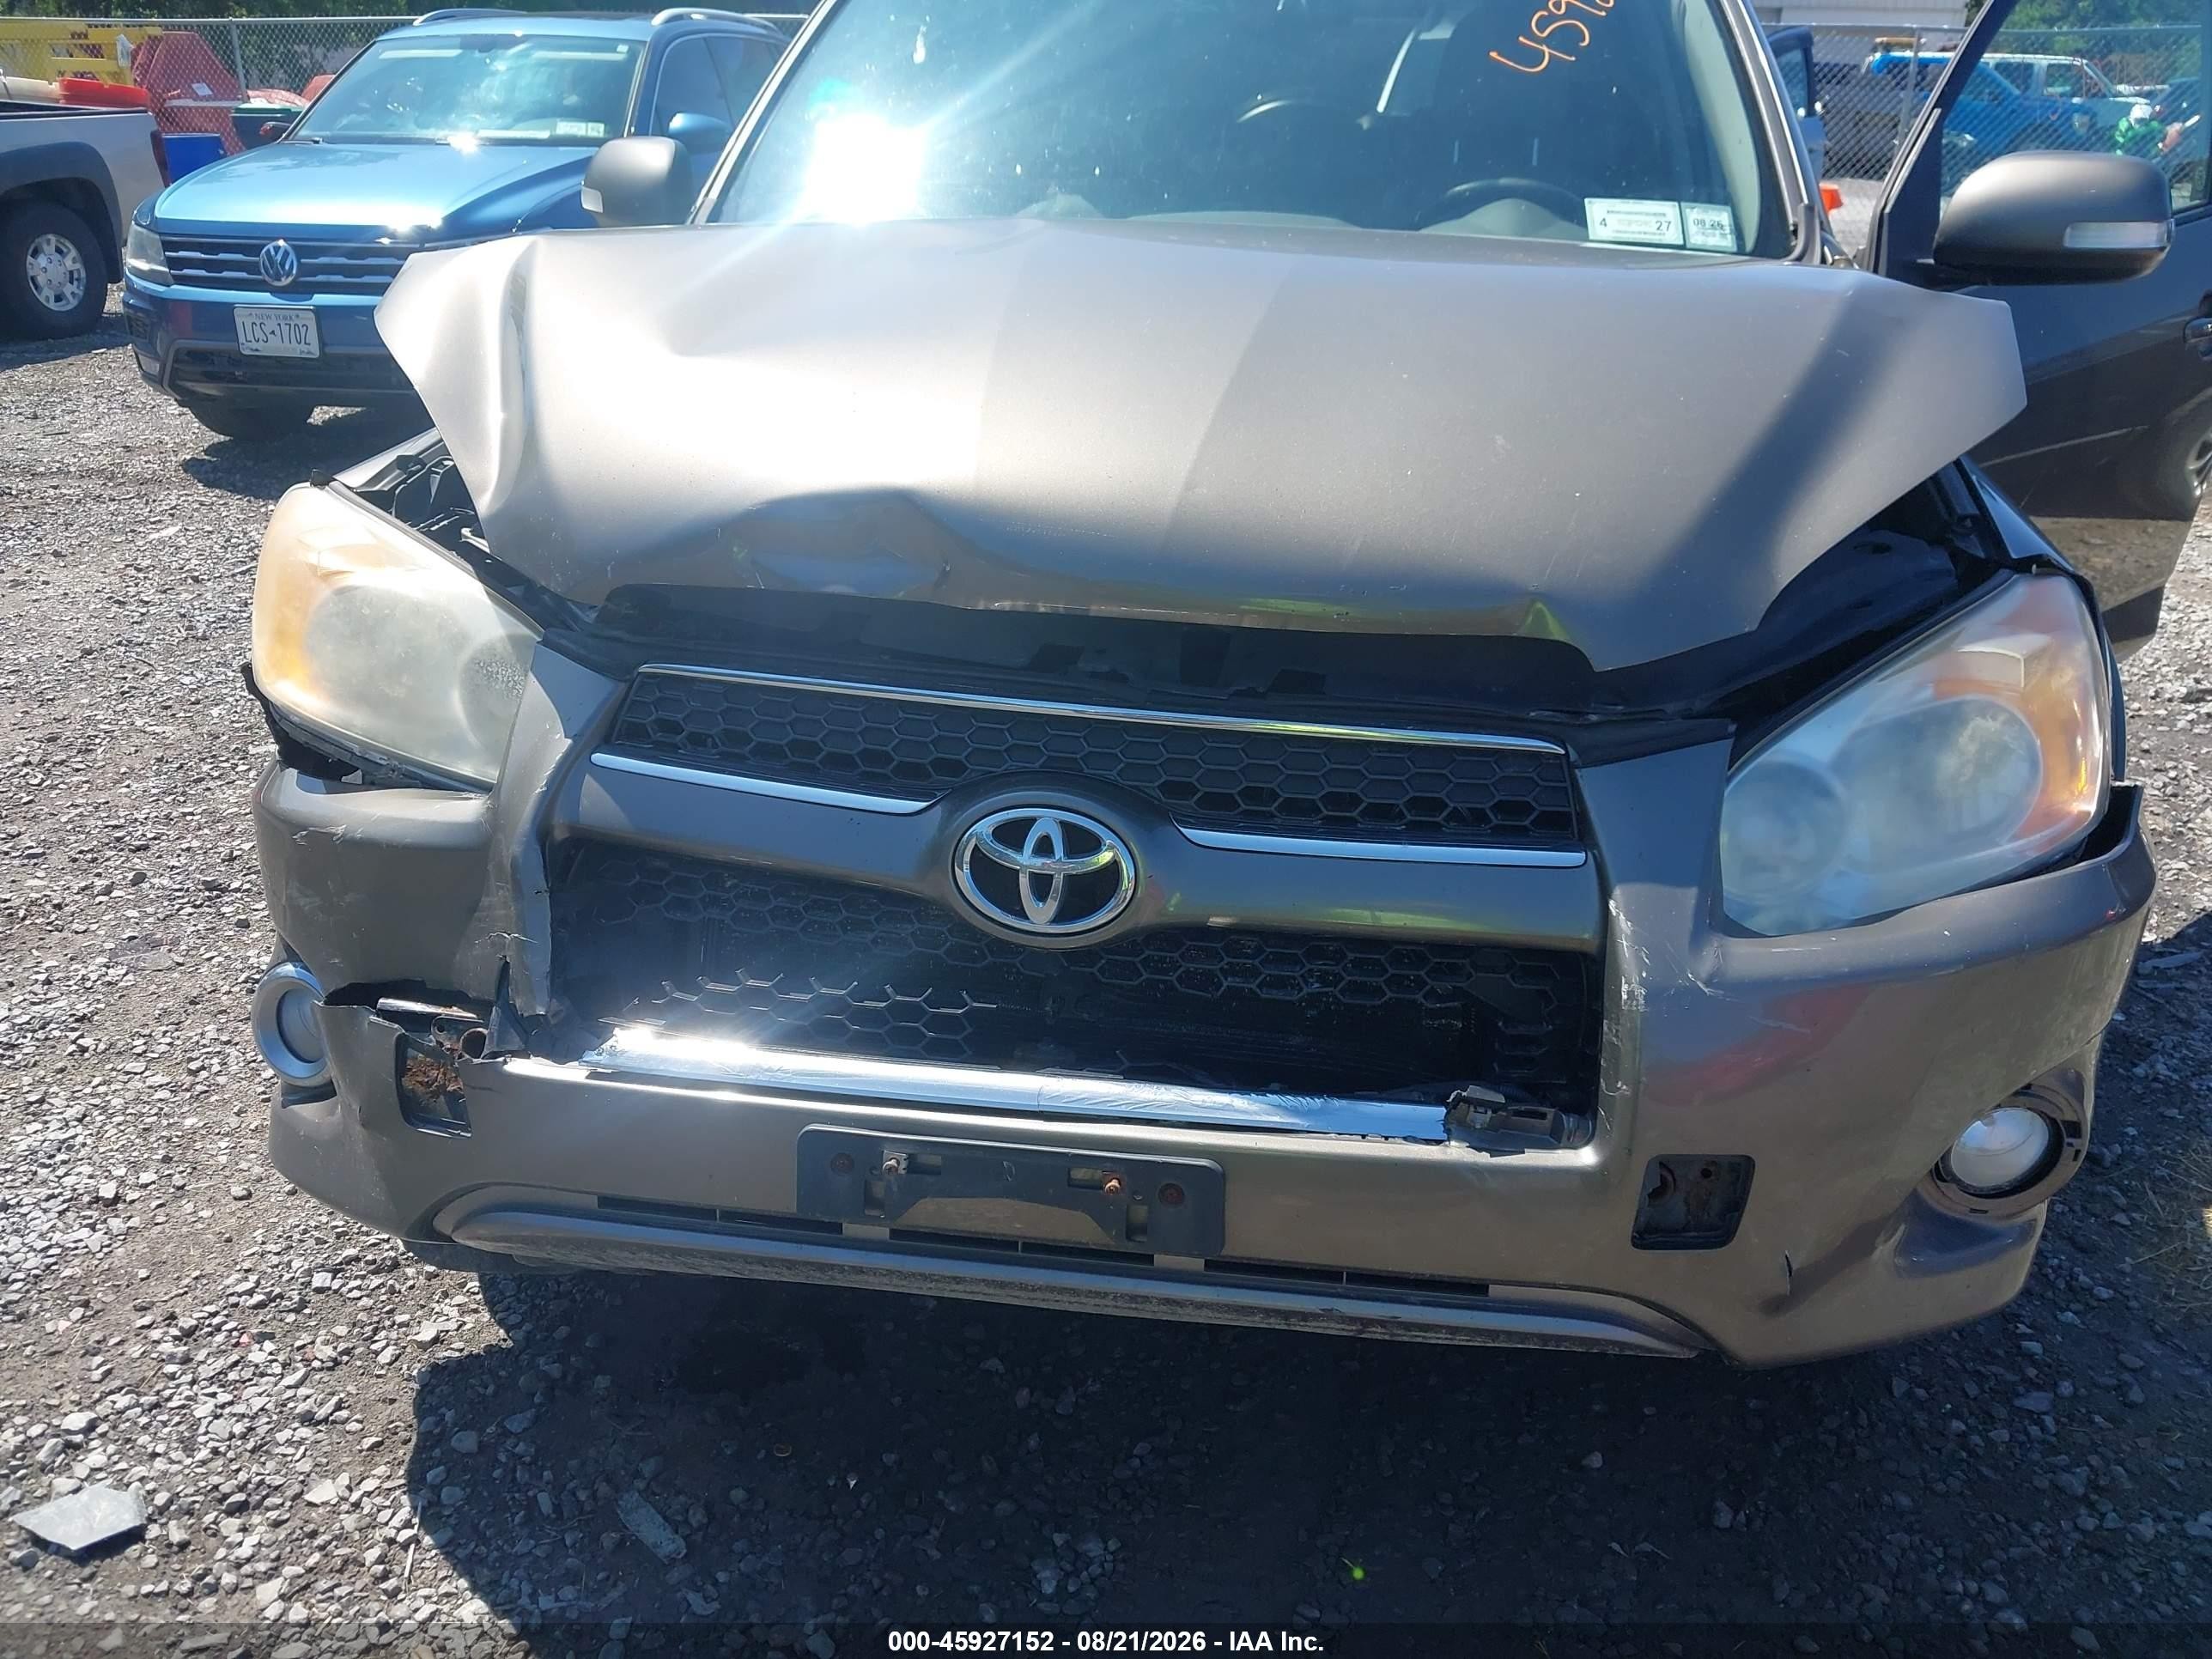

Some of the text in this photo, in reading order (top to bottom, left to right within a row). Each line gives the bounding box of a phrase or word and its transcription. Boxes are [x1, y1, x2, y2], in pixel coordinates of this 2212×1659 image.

[1599, 216, 1608, 228] 4
[1655, 219, 1673, 232] 27
[274, 313, 295, 322] YORK
